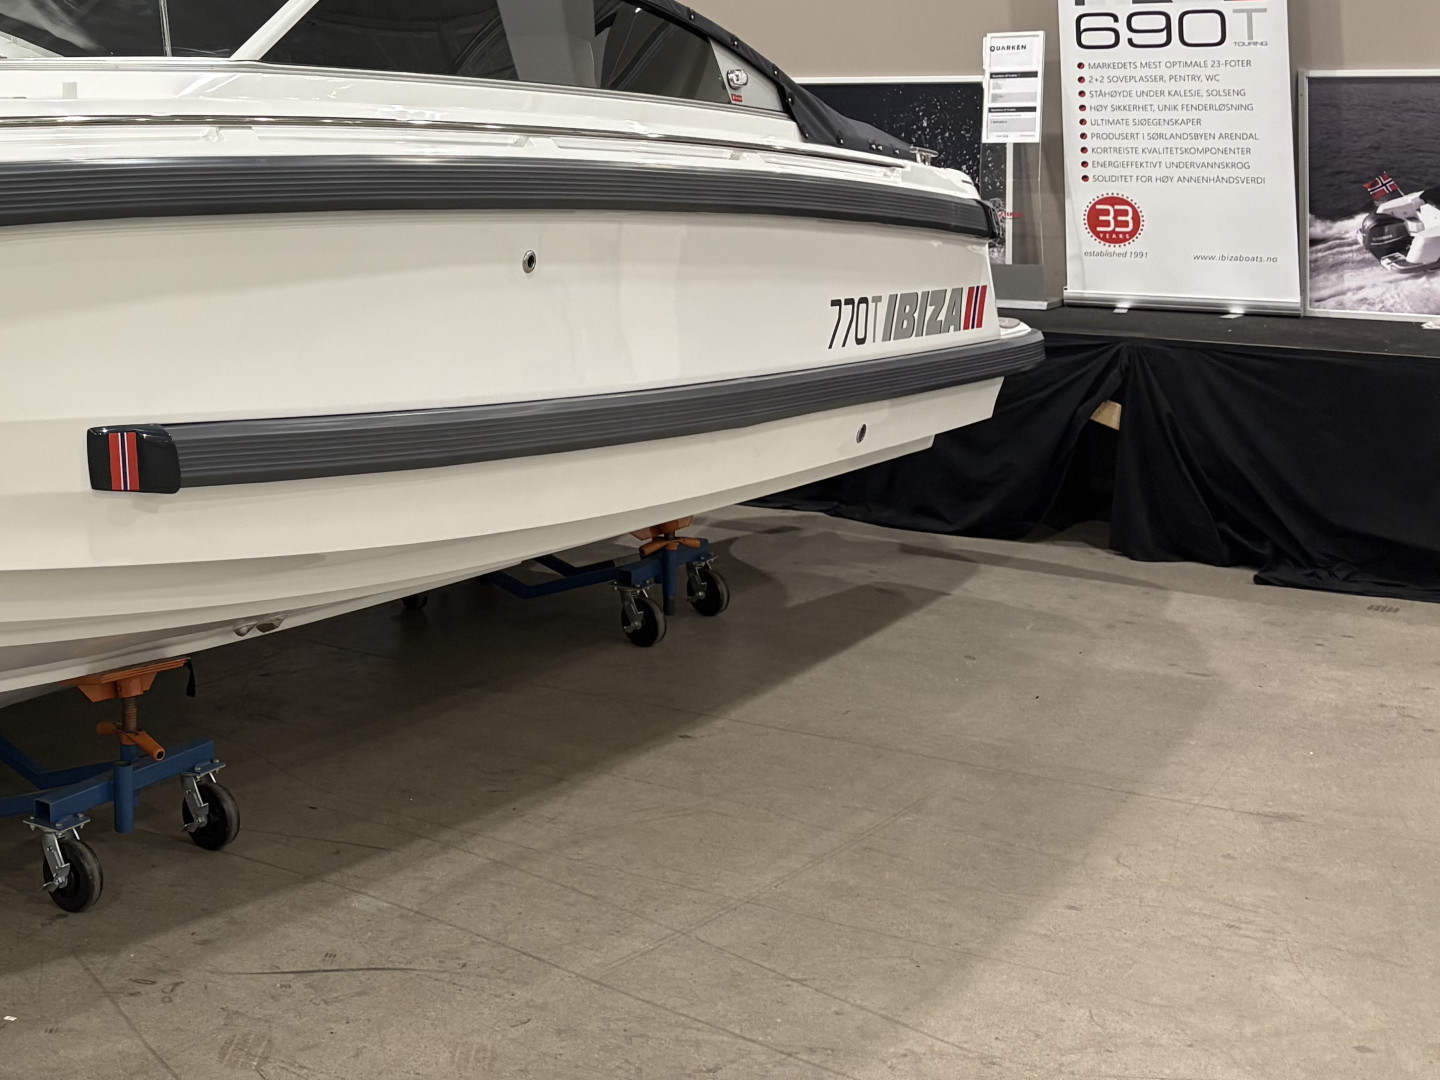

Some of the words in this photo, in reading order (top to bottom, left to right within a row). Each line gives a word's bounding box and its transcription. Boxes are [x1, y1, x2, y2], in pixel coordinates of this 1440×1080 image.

[990, 44, 1027, 52] QUARKEN
[1088, 62, 1138, 70] MARKEDETS
[1140, 61, 1162, 69] MEST
[1165, 60, 1209, 69] OPTIMALE
[1211, 60, 1252, 68] 23-FOTER
[1088, 76, 1104, 84] 2+2
[1107, 75, 1166, 83] SOVEPLASSER,
[1169, 74, 1203, 82] PENTRY,
[1205, 74, 1220, 82] WC
[1089, 89, 1133, 98] STÅHØYDE
[1136, 90, 1165, 98] UNDER
[1168, 89, 1203, 98] KALESJE,
[1206, 89, 1246, 97] SOLSENG
[1090, 104, 1108, 112] HØY
[1111, 104, 1155, 113] SIKKERHET,
[1157, 104, 1179, 112] UNIK
[1181, 103, 1254, 112] FENDERLØSNING
[1090, 118, 1130, 126] ULTIMATE
[1132, 118, 1202, 126] SJØEGENSKAPER
[1091, 132, 1140, 140] PRODUSERT
[1147, 132, 1216, 140] SØRLANDSBYEN
[1218, 132, 1260, 141] ARENDAL
[1091, 146, 1140, 155] KORTREISTE
[1142, 146, 1252, 155] KVALITETSKOMPONENTER
[1165, 161, 1251, 169] UNDERVANNSKROG
[1092, 175, 1133, 183] SOLIDITET
[1136, 175, 1153, 183] FOR
[1156, 175, 1174, 183] HØY
[1176, 175, 1266, 184] ANNENHÅNDSVERDI
[1095, 204, 1134, 232] 33
[1084, 250, 1127, 258] established
[1129, 251, 1148, 259] 1991
[1193, 254, 1278, 263] www.ibizaboats.no
[882, 287, 964, 342] IBIZA
